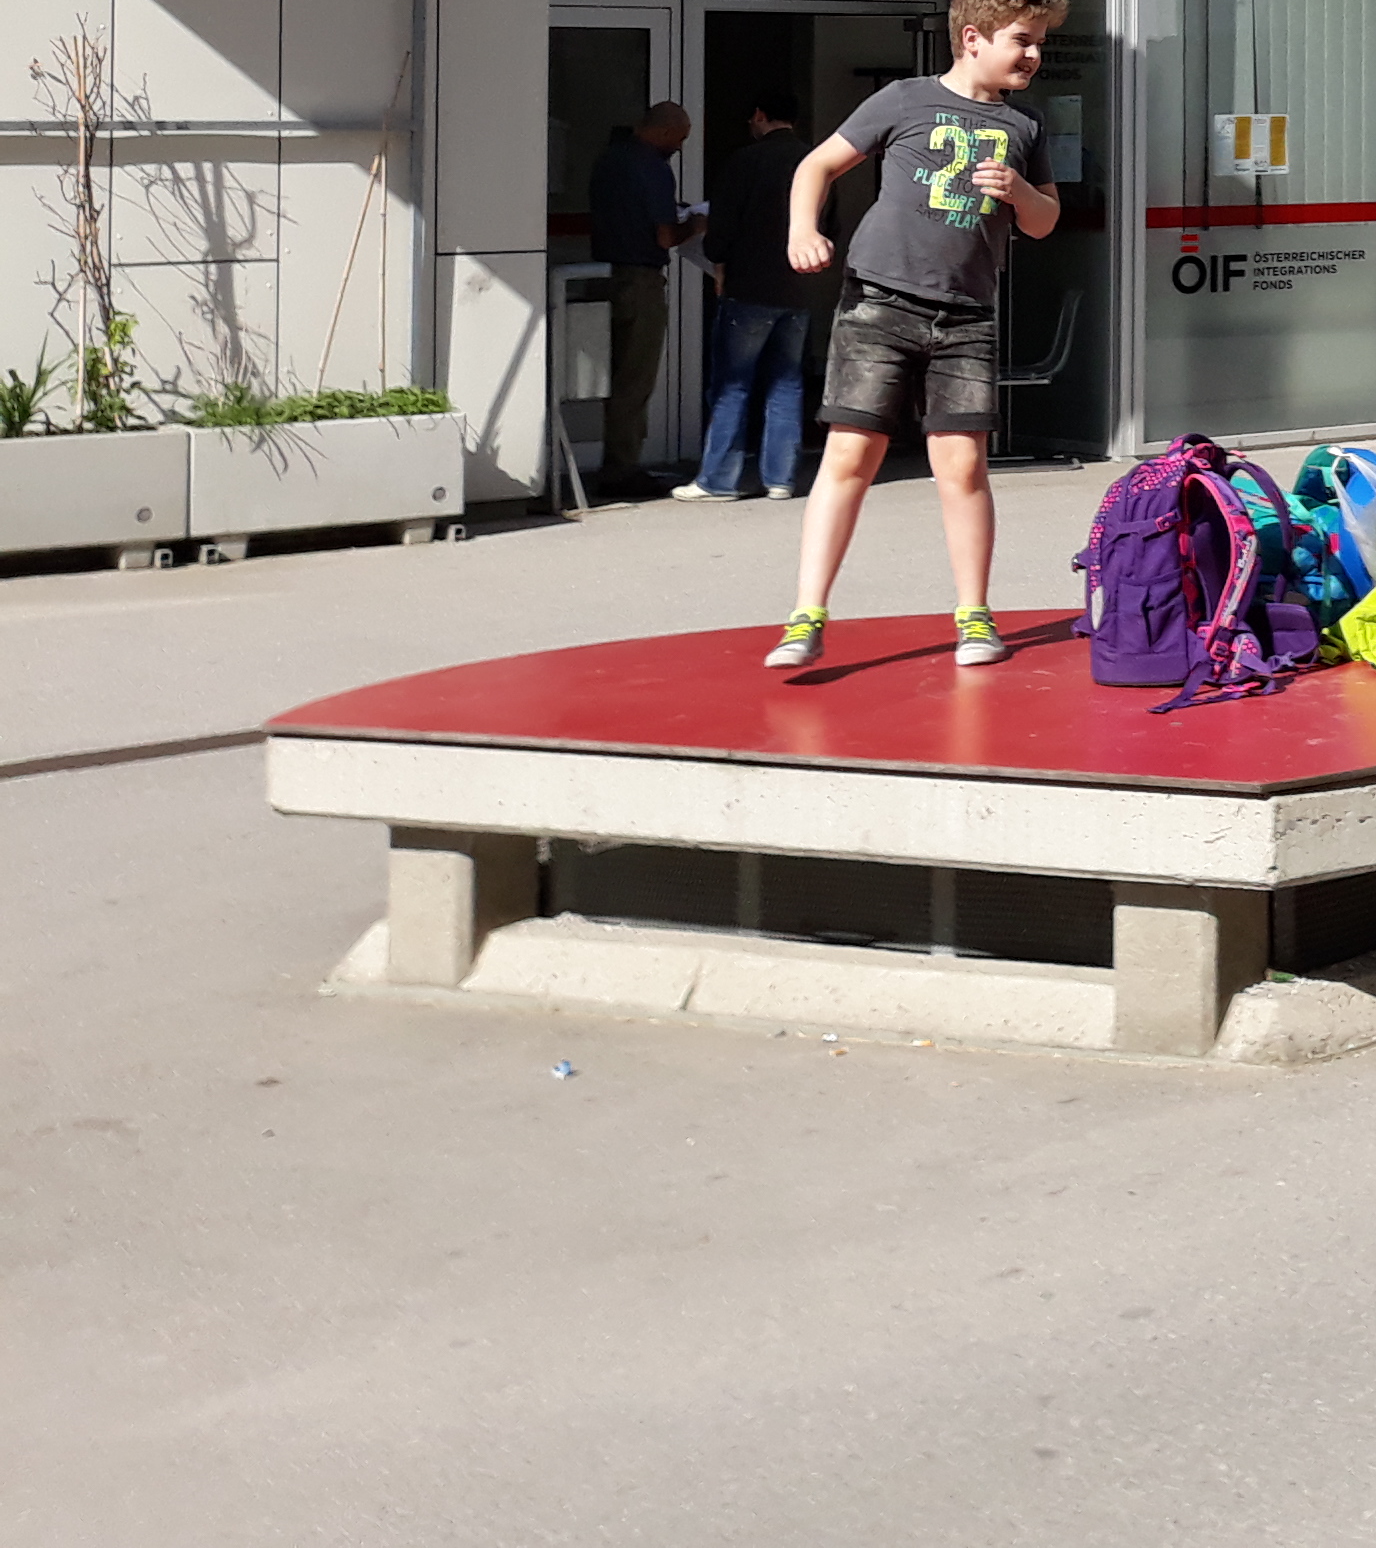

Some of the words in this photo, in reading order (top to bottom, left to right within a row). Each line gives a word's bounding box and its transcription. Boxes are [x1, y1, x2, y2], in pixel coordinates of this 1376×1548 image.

[935, 113, 959, 126] IT'S
[944, 127, 981, 147] RIGHT
[913, 167, 955, 190] PLACE
[940, 192, 976, 211] SURF
[945, 211, 980, 229] PLAY
[1253, 250, 1366, 264] ÖSTERREICHISCHER
[1253, 265, 1338, 277] INTEGRATIONS
[1253, 280, 1293, 291] FONDS
